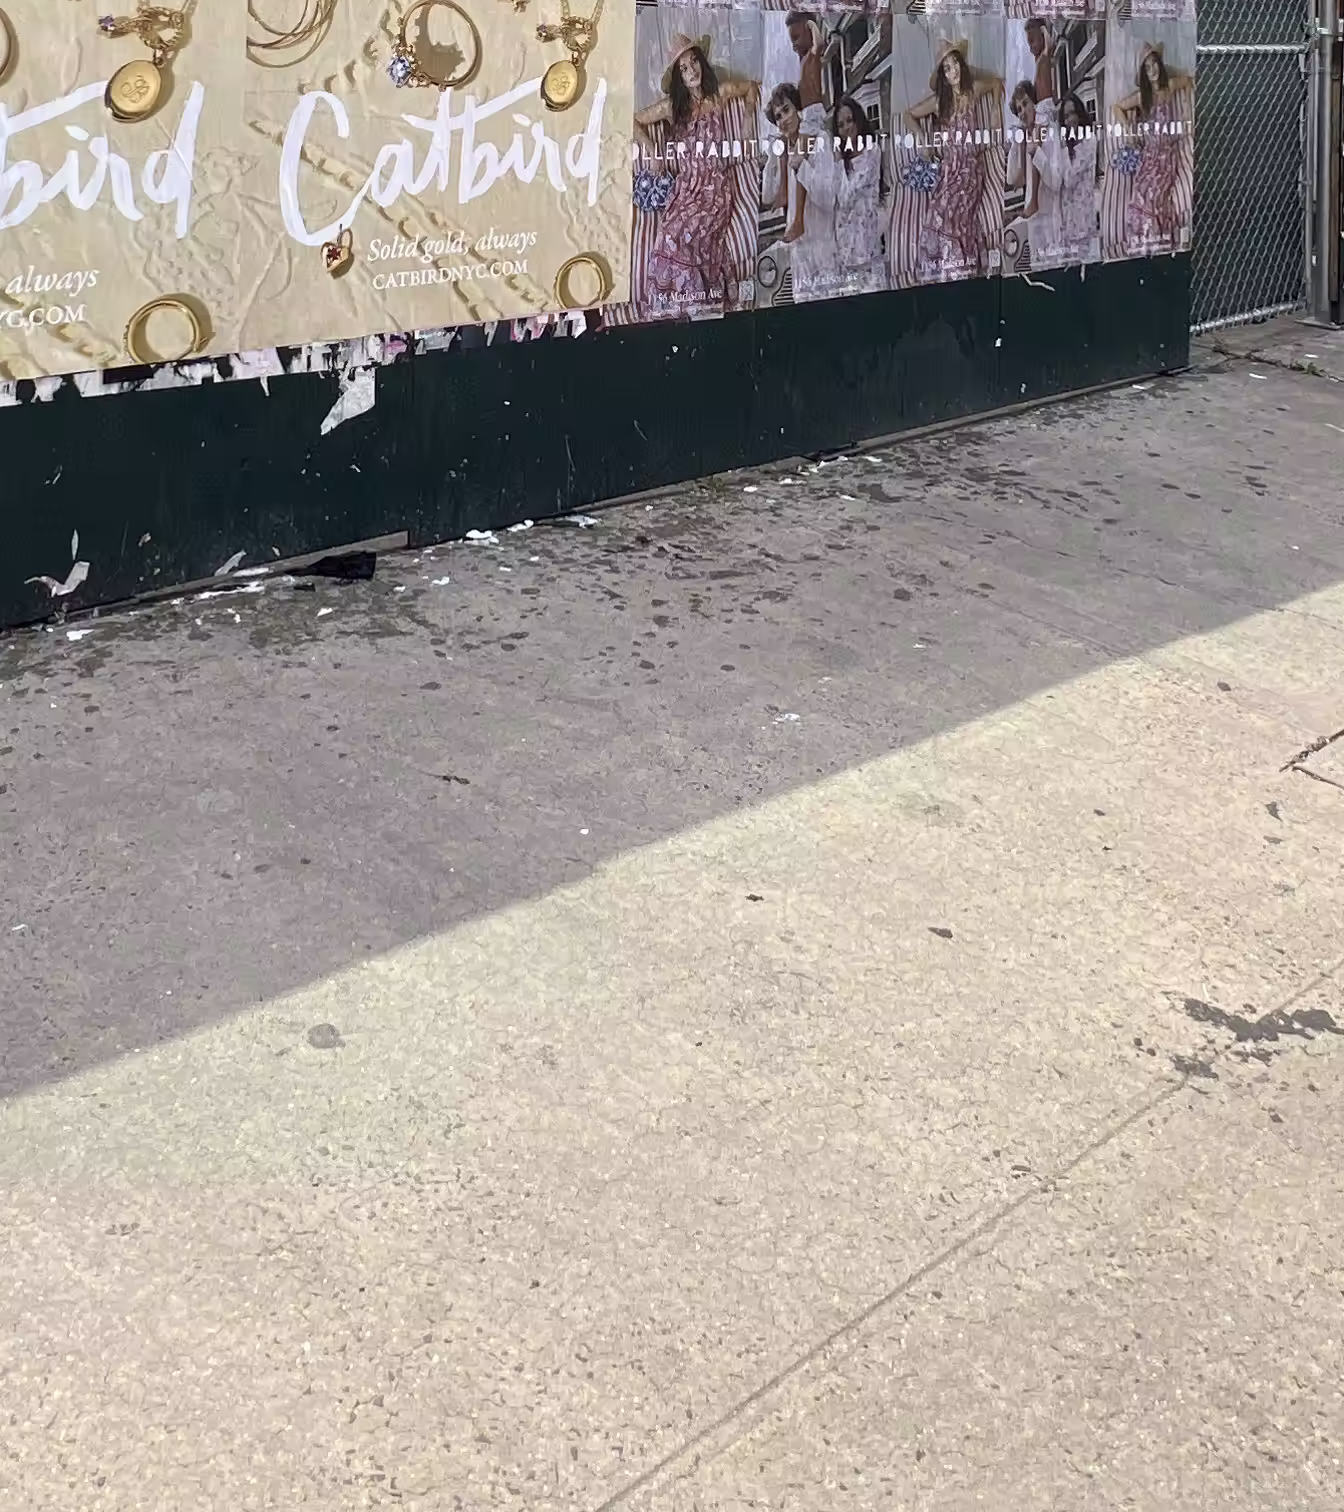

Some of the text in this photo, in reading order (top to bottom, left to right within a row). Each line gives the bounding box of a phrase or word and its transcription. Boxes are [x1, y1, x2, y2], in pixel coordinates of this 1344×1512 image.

[760, 132, 888, 157] ROLLER RABBIT
[895, 127, 1002, 149] ROLLER RABBIT
[1006, 124, 1103, 144] ROLLER RABBIT
[279, 76, 607, 247] Catbird
[632, 139, 757, 160] OLLER RABBIT
[367, 227, 538, 264] Solid gold, always
[4, 265, 100, 297] always
[372, 259, 528, 290] CATBIRDNYC.COM
